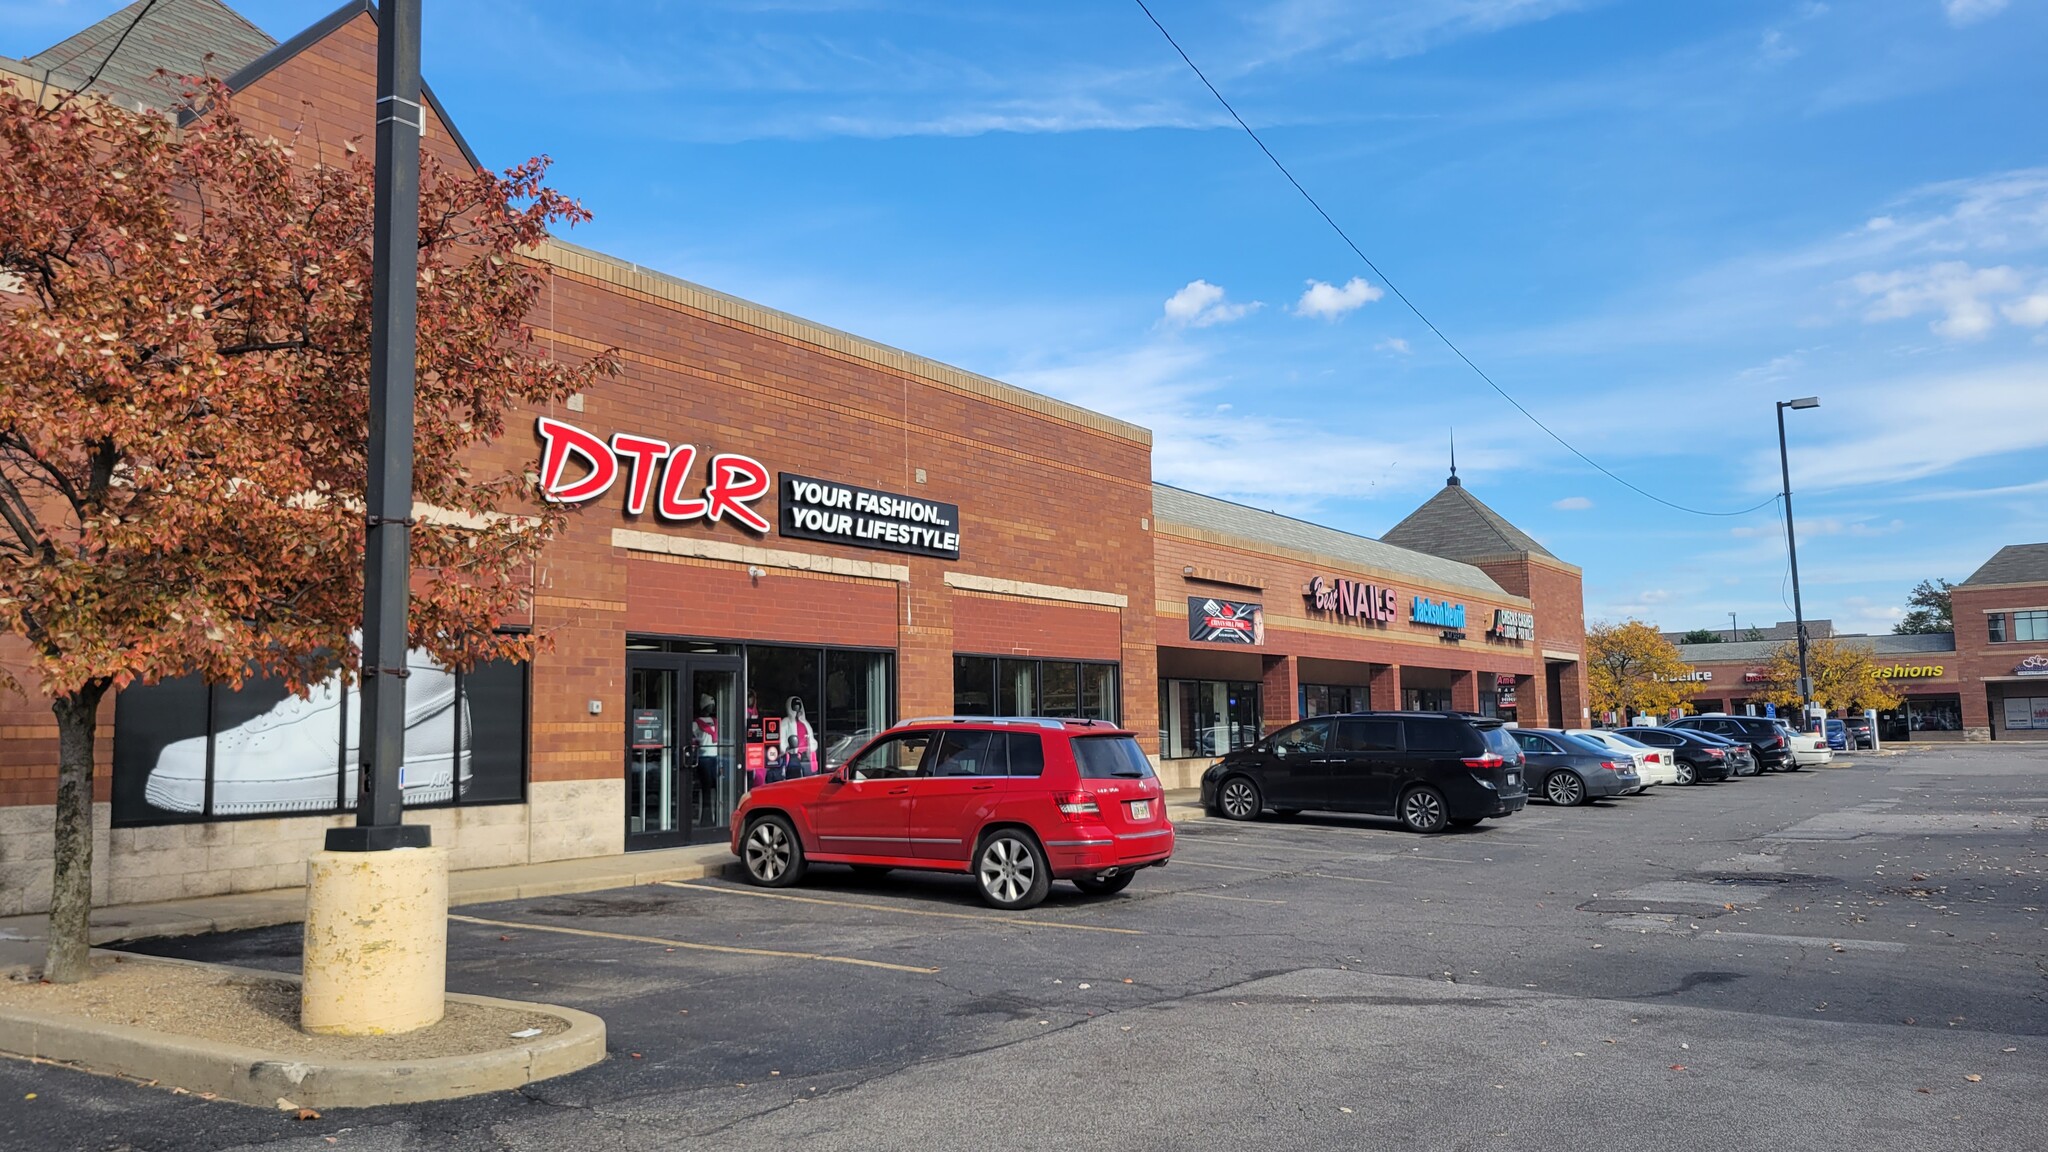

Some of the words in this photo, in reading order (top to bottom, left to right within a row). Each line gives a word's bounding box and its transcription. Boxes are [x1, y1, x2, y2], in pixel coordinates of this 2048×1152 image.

[537, 416, 771, 533] DTLR
[791, 480, 853, 510] YOUR
[855, 492, 950, 527] FASHION...
[791, 507, 853, 536] YOUR
[855, 517, 960, 551] LIFESTYLE!
[1311, 576, 1338, 612] Best
[1336, 578, 1398, 623] NAILS
[1414, 596, 1445, 626] Jackson
[1868, 663, 1943, 680] ashions
[431, 772, 451, 788] AIR
